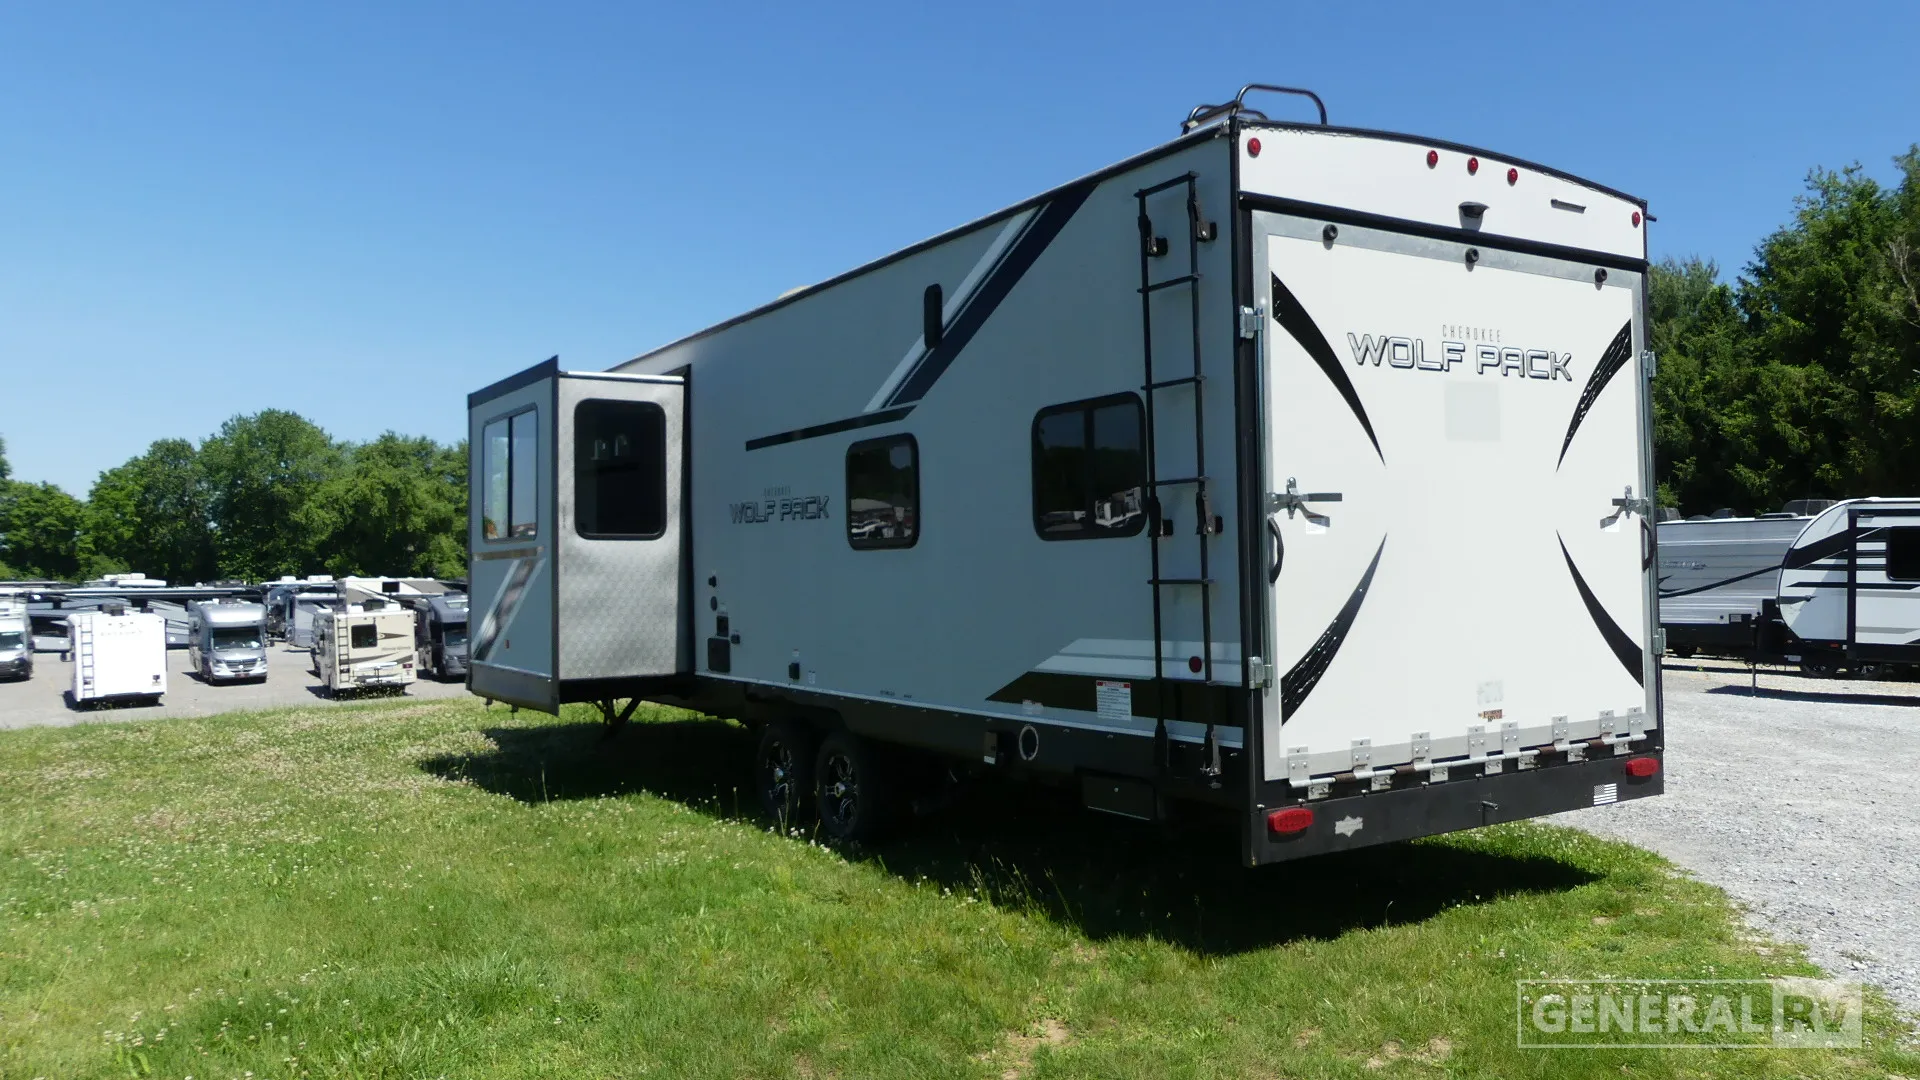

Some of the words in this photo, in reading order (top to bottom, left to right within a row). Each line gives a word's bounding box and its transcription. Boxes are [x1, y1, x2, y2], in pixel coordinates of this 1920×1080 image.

[1442, 324, 1500, 342] CHEROKEE
[1347, 332, 1465, 371] WOLF
[1476, 345, 1572, 381] PACK
[729, 500, 776, 524] WOLF
[780, 495, 830, 521] PACK
